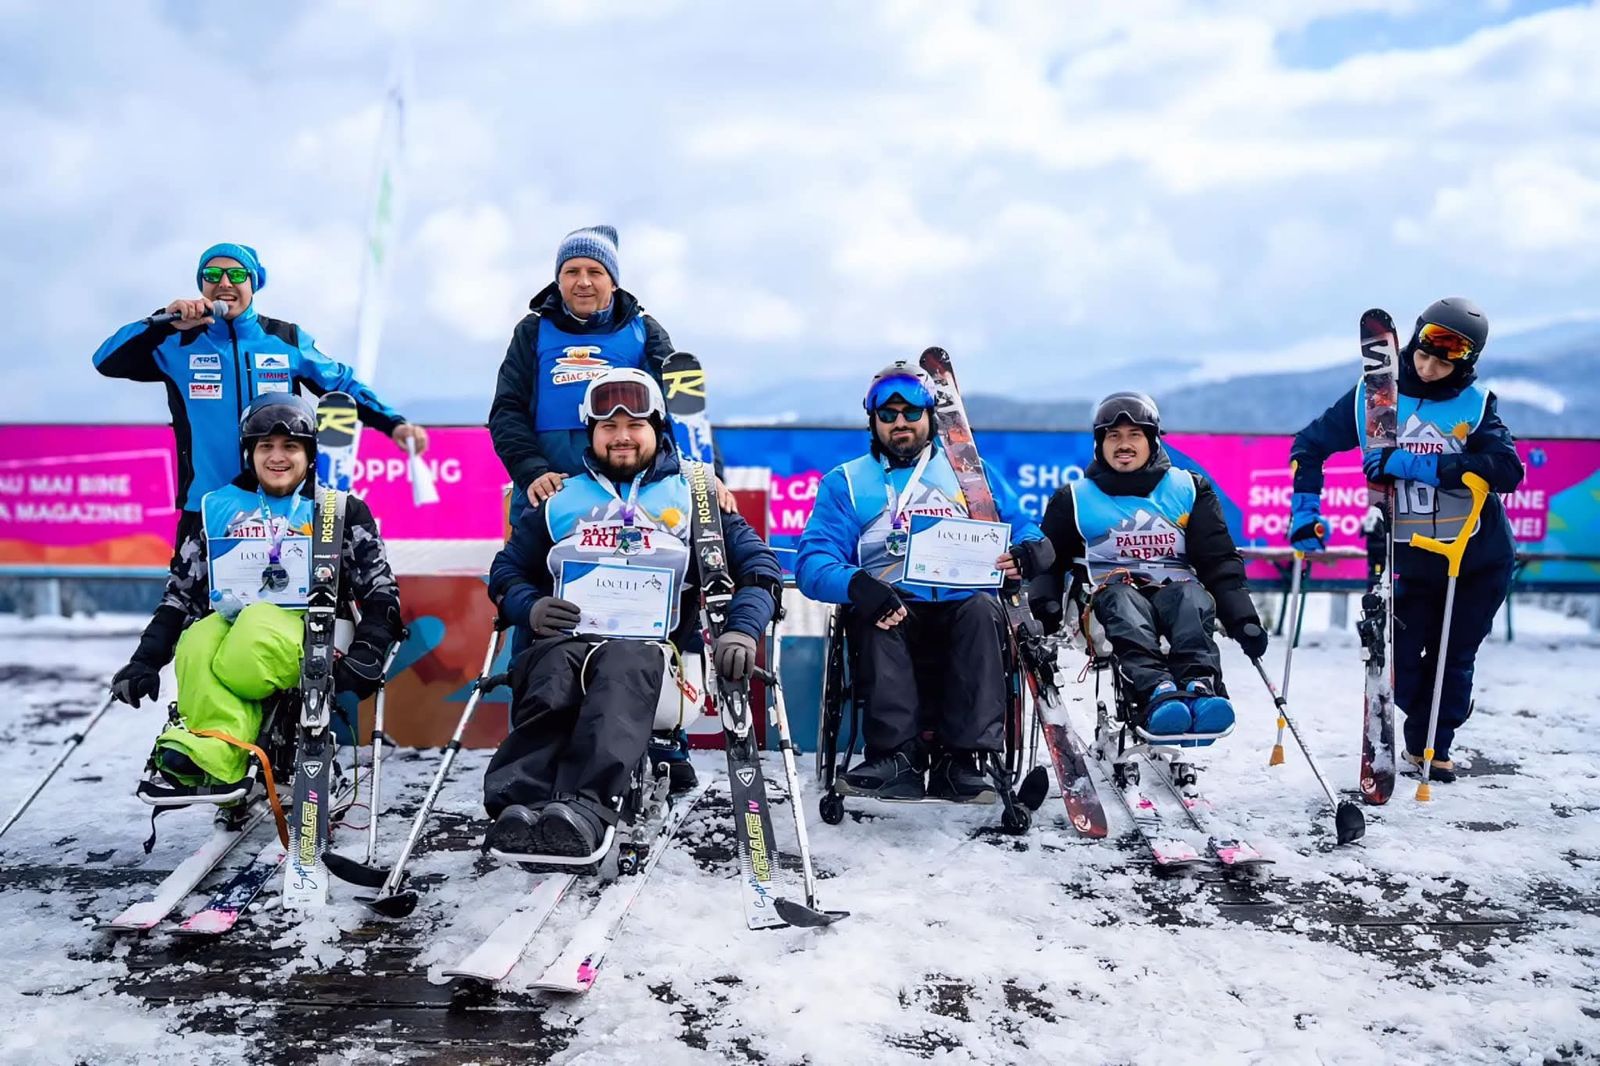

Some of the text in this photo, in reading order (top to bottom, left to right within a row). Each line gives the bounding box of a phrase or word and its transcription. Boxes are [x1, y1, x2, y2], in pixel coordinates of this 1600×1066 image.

[555, 373, 583, 384] CAIAC
[30, 475, 73, 495] MAI
[78, 474, 131, 497] BINE
[1120, 546, 1175, 559] ARENA
[309, 790, 319, 803] IV
[748, 799, 761, 813] IV
